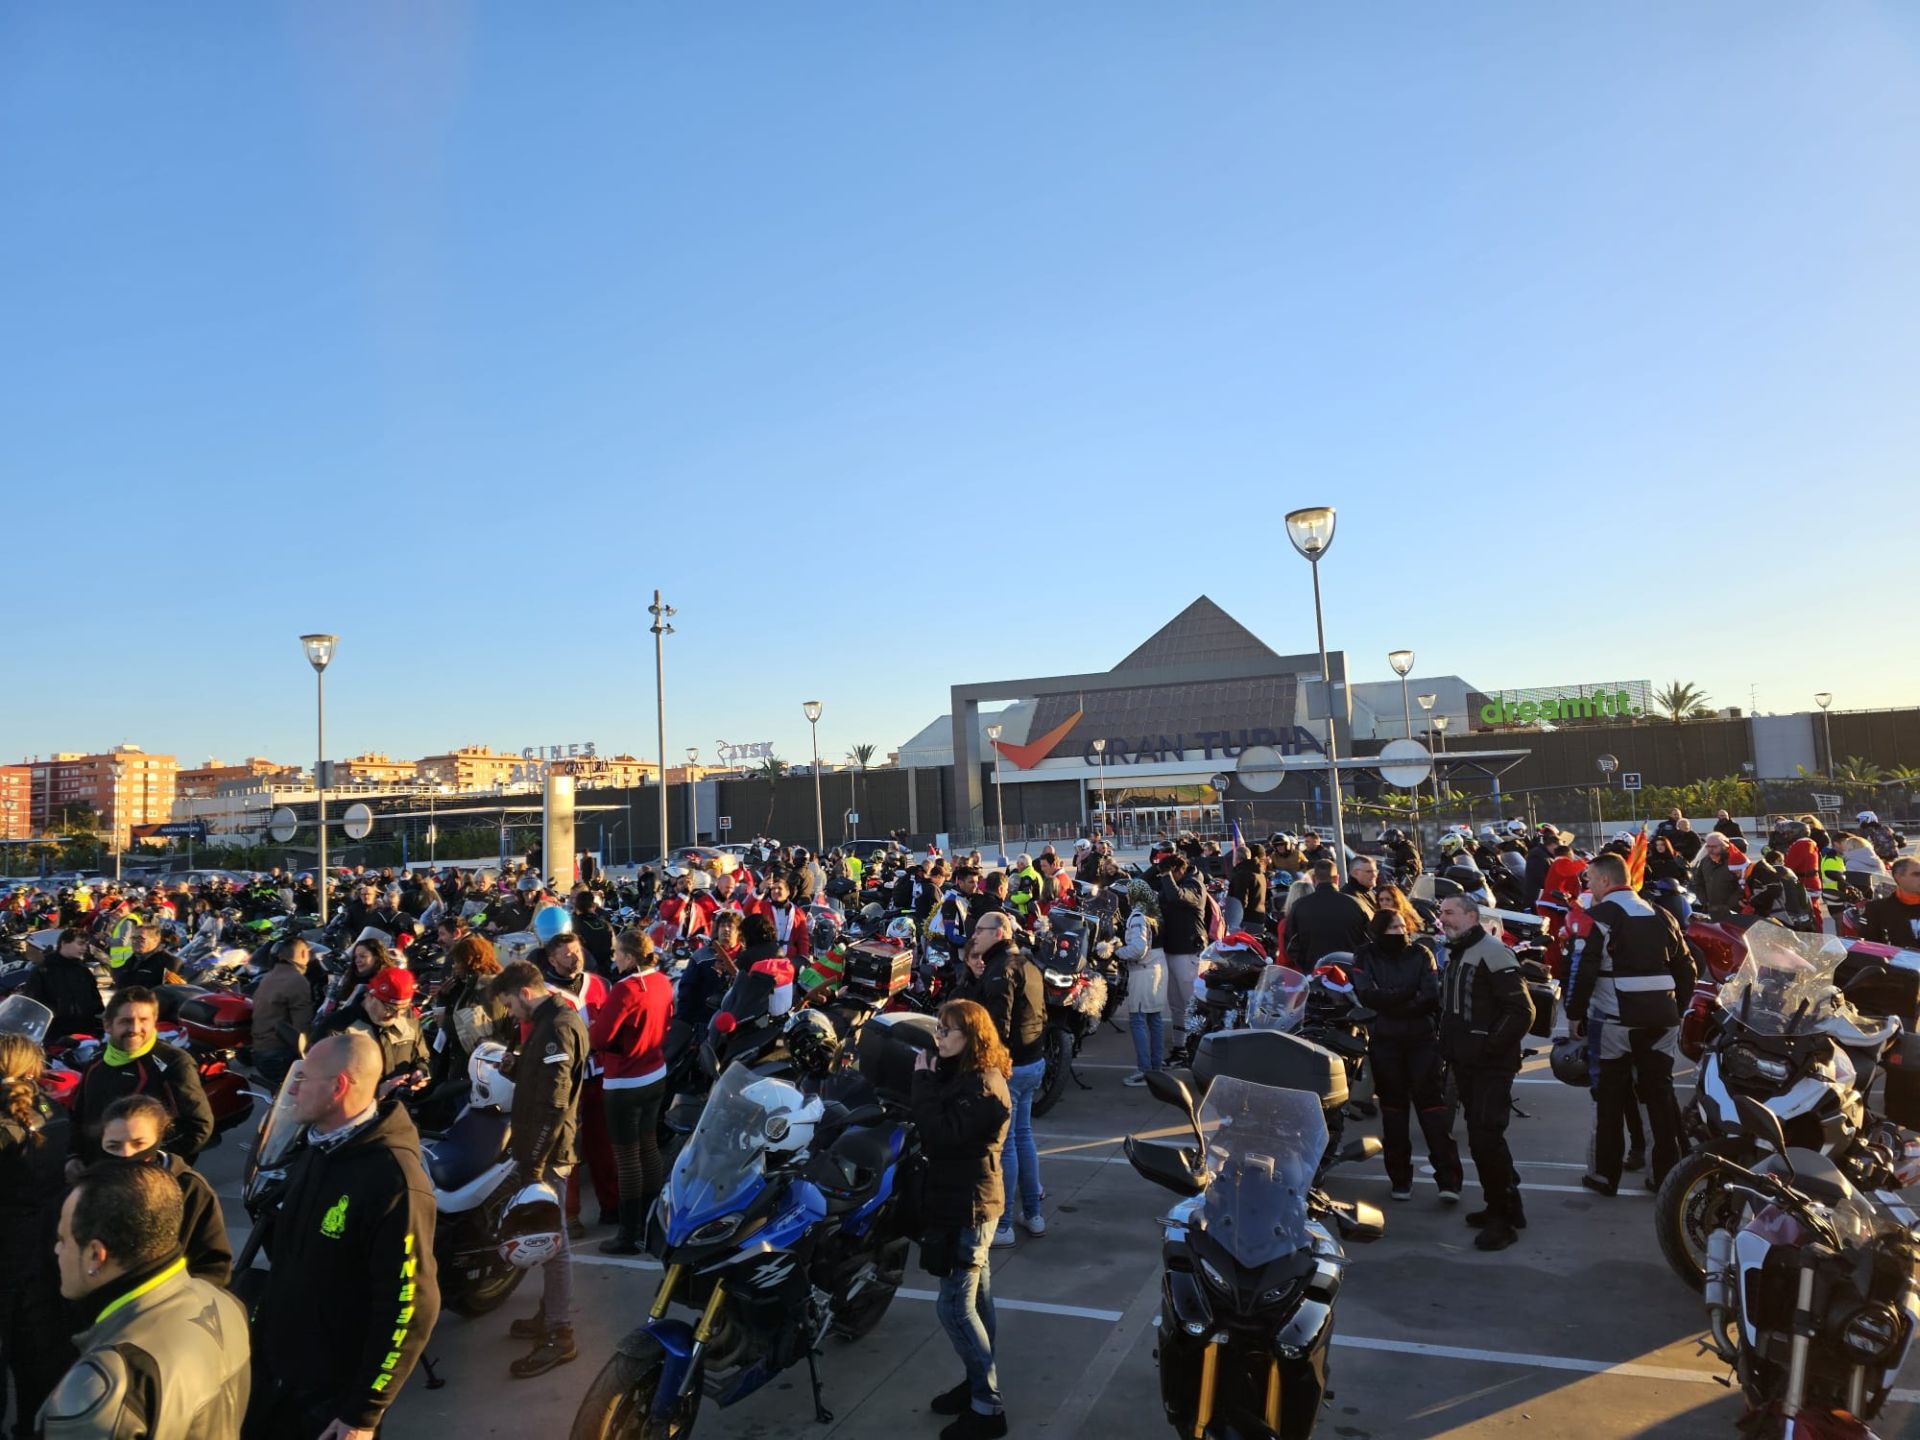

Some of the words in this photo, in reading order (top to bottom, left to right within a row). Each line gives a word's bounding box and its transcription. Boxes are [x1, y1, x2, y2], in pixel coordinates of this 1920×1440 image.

[522, 741, 595, 761] CINES
[729, 741, 774, 760] JYSK
[1083, 734, 1184, 767] GRAN
[1196, 726, 1327, 761] TURIA
